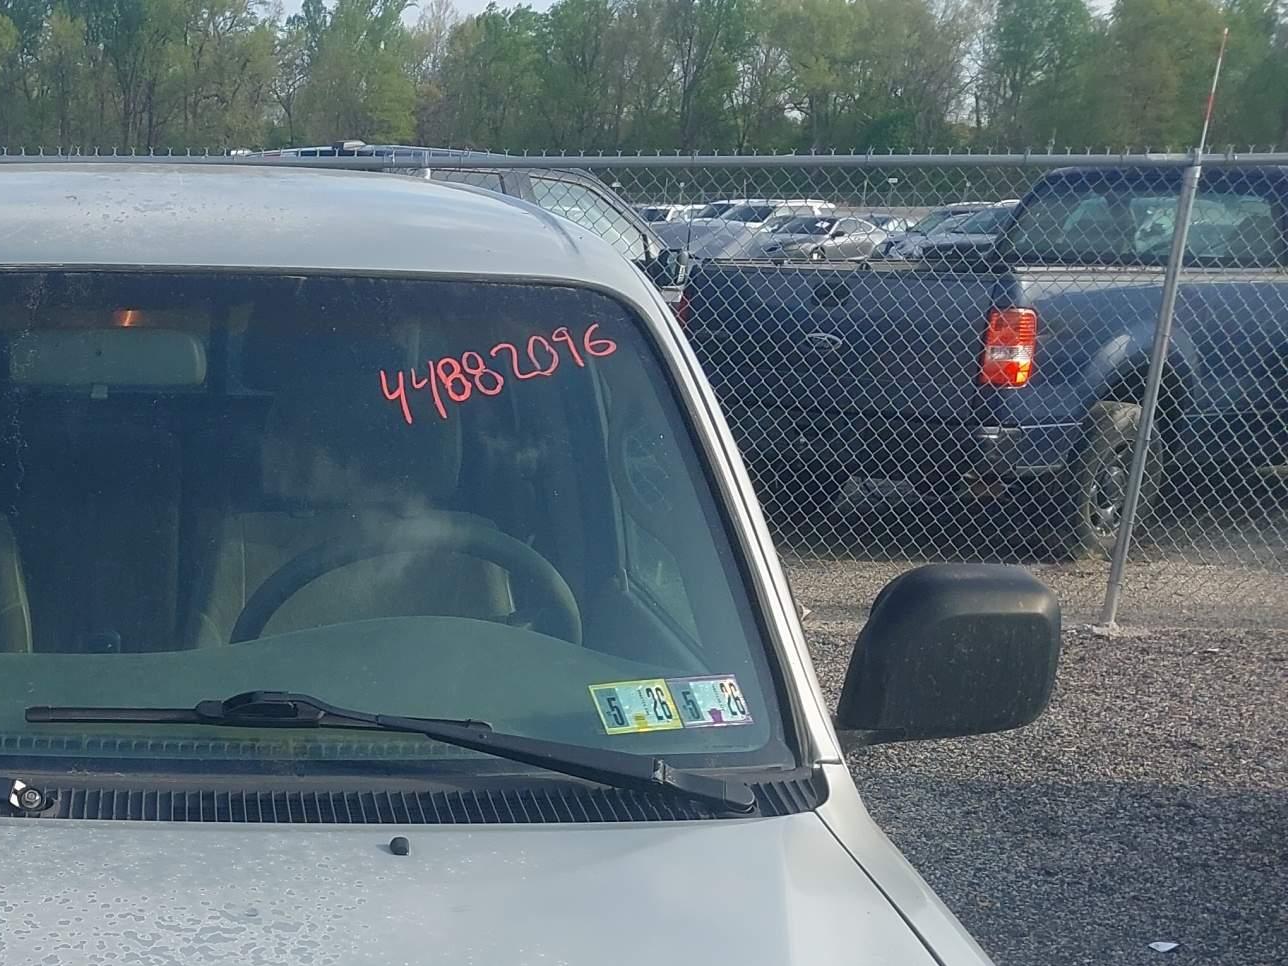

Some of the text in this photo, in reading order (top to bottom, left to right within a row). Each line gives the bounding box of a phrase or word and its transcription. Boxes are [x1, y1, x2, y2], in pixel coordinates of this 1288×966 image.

[379, 322, 617, 425] 44882096
[607, 697, 625, 726] 5
[646, 687, 672, 721] 26
[720, 682, 746, 716] 26
